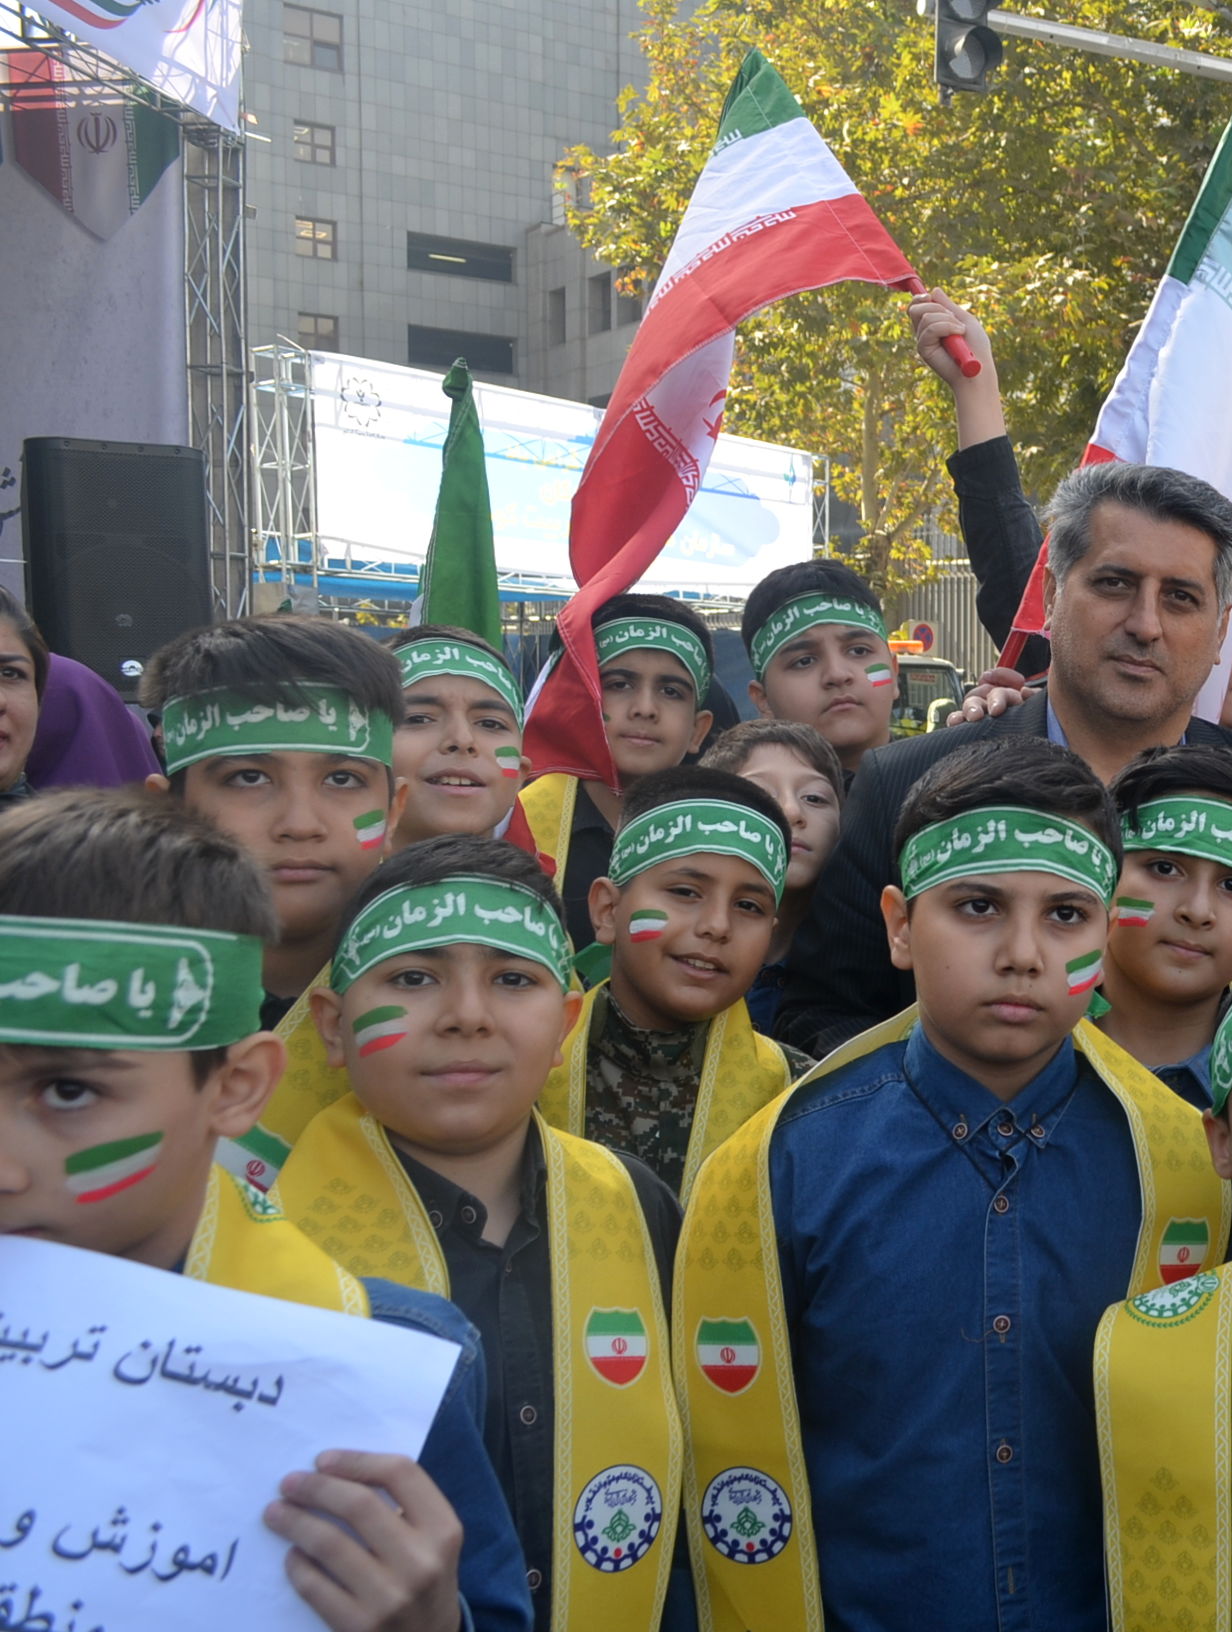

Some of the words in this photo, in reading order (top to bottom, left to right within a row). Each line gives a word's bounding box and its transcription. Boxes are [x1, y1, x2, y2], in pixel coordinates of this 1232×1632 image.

[803, 598, 852, 617] صاحب
[615, 625, 667, 643] الزمان
[767, 606, 800, 647] الزمان
[671, 635, 703, 666] صاحب
[465, 655, 512, 689] صاحب
[175, 703, 221, 746] الزمان
[226, 701, 310, 731] صاحب
[318, 699, 338, 732] یا
[636, 814, 692, 854] الزمان
[697, 820, 762, 843] صاحب
[937, 819, 1007, 863] الزمان
[1014, 828, 1089, 855] صاحب
[1142, 810, 1207, 840] الزمان
[765, 834, 774, 860] یا
[1092, 846, 1102, 872] یا
[383, 892, 467, 939] الزمان
[474, 903, 545, 937] صاحب
[548, 925, 558, 957] یا
[0, 962, 118, 1006] صاح
[129, 967, 156, 1018] یا
[112, 1336, 285, 1414] دبستان
[0, 1507, 37, 1548] و
[51, 1506, 239, 1582] اموزش
